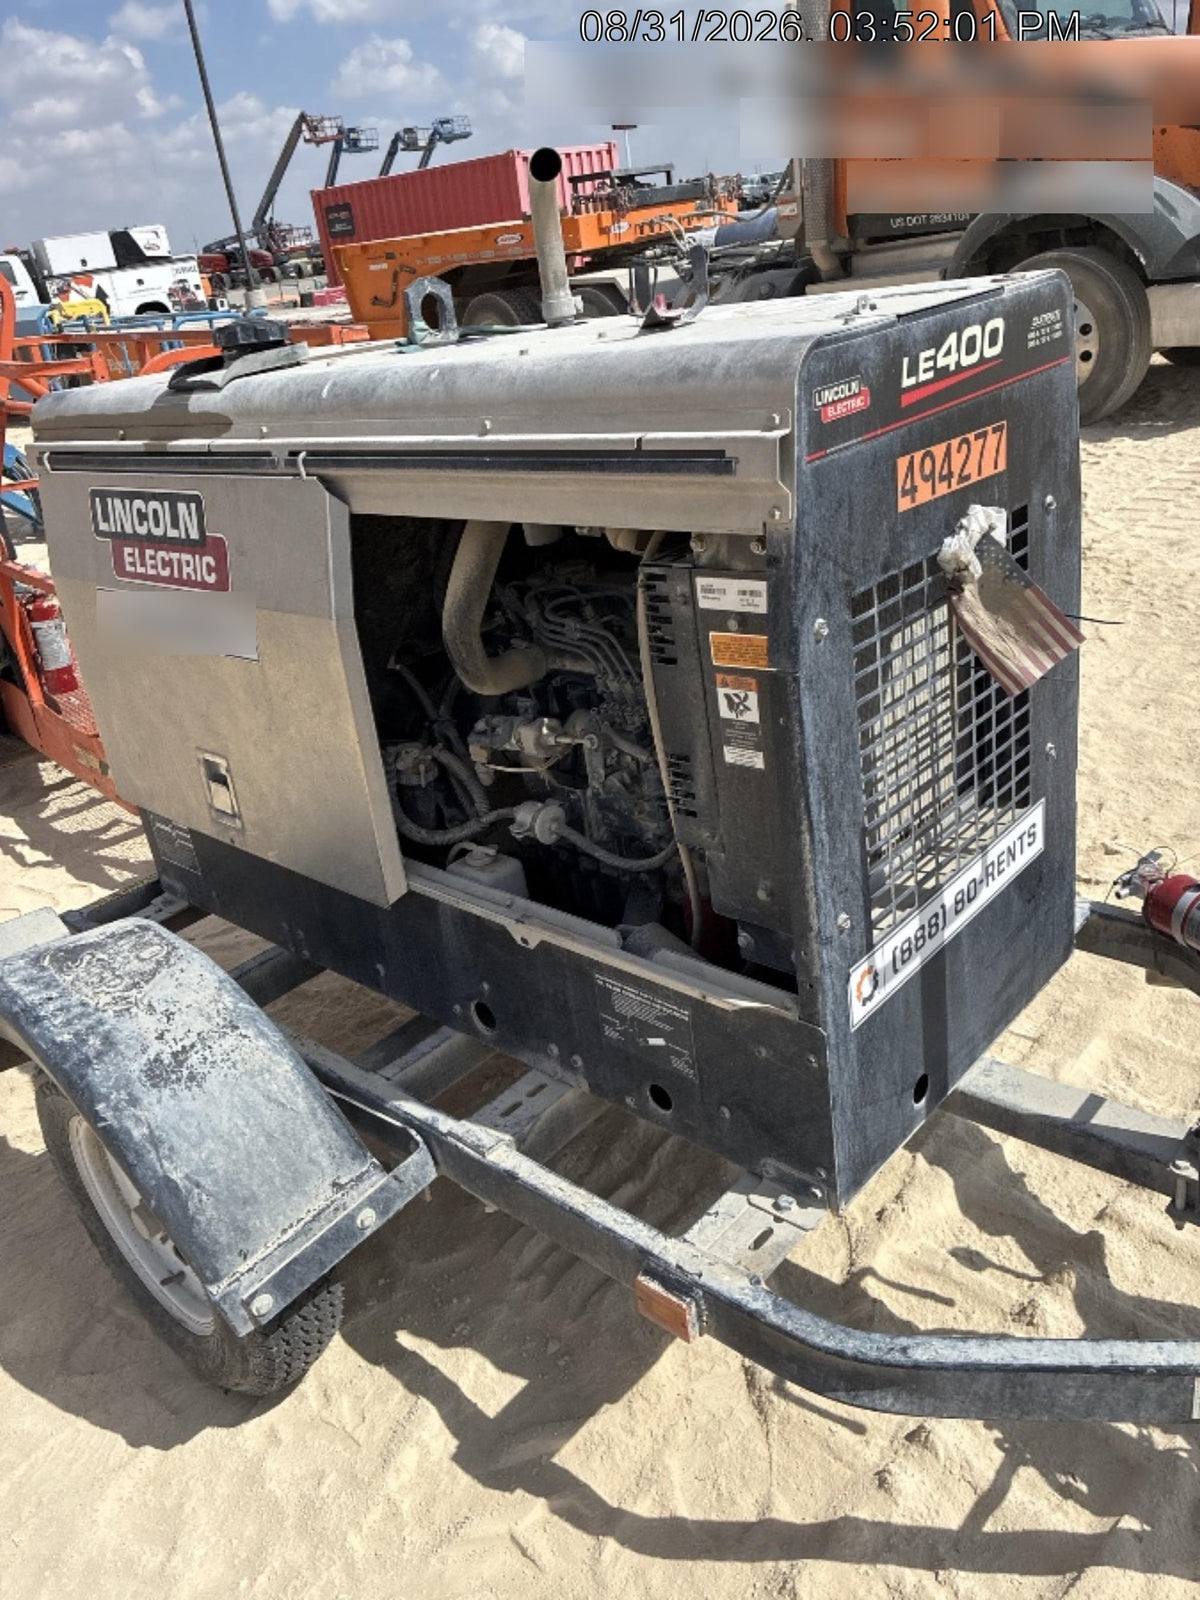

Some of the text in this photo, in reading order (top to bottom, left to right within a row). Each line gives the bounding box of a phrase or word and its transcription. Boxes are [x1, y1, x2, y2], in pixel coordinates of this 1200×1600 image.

[906, 214, 927, 227] DOT
[901, 317, 1005, 388] LE400
[815, 380, 860, 406] LINCOLN
[827, 396, 865, 417] ELECTRIC
[900, 422, 1005, 504] 494277
[95, 497, 200, 539] LINCOLN
[123, 546, 217, 584] ELECTRIC
[892, 822, 1037, 974] (888) 80-RENTS
